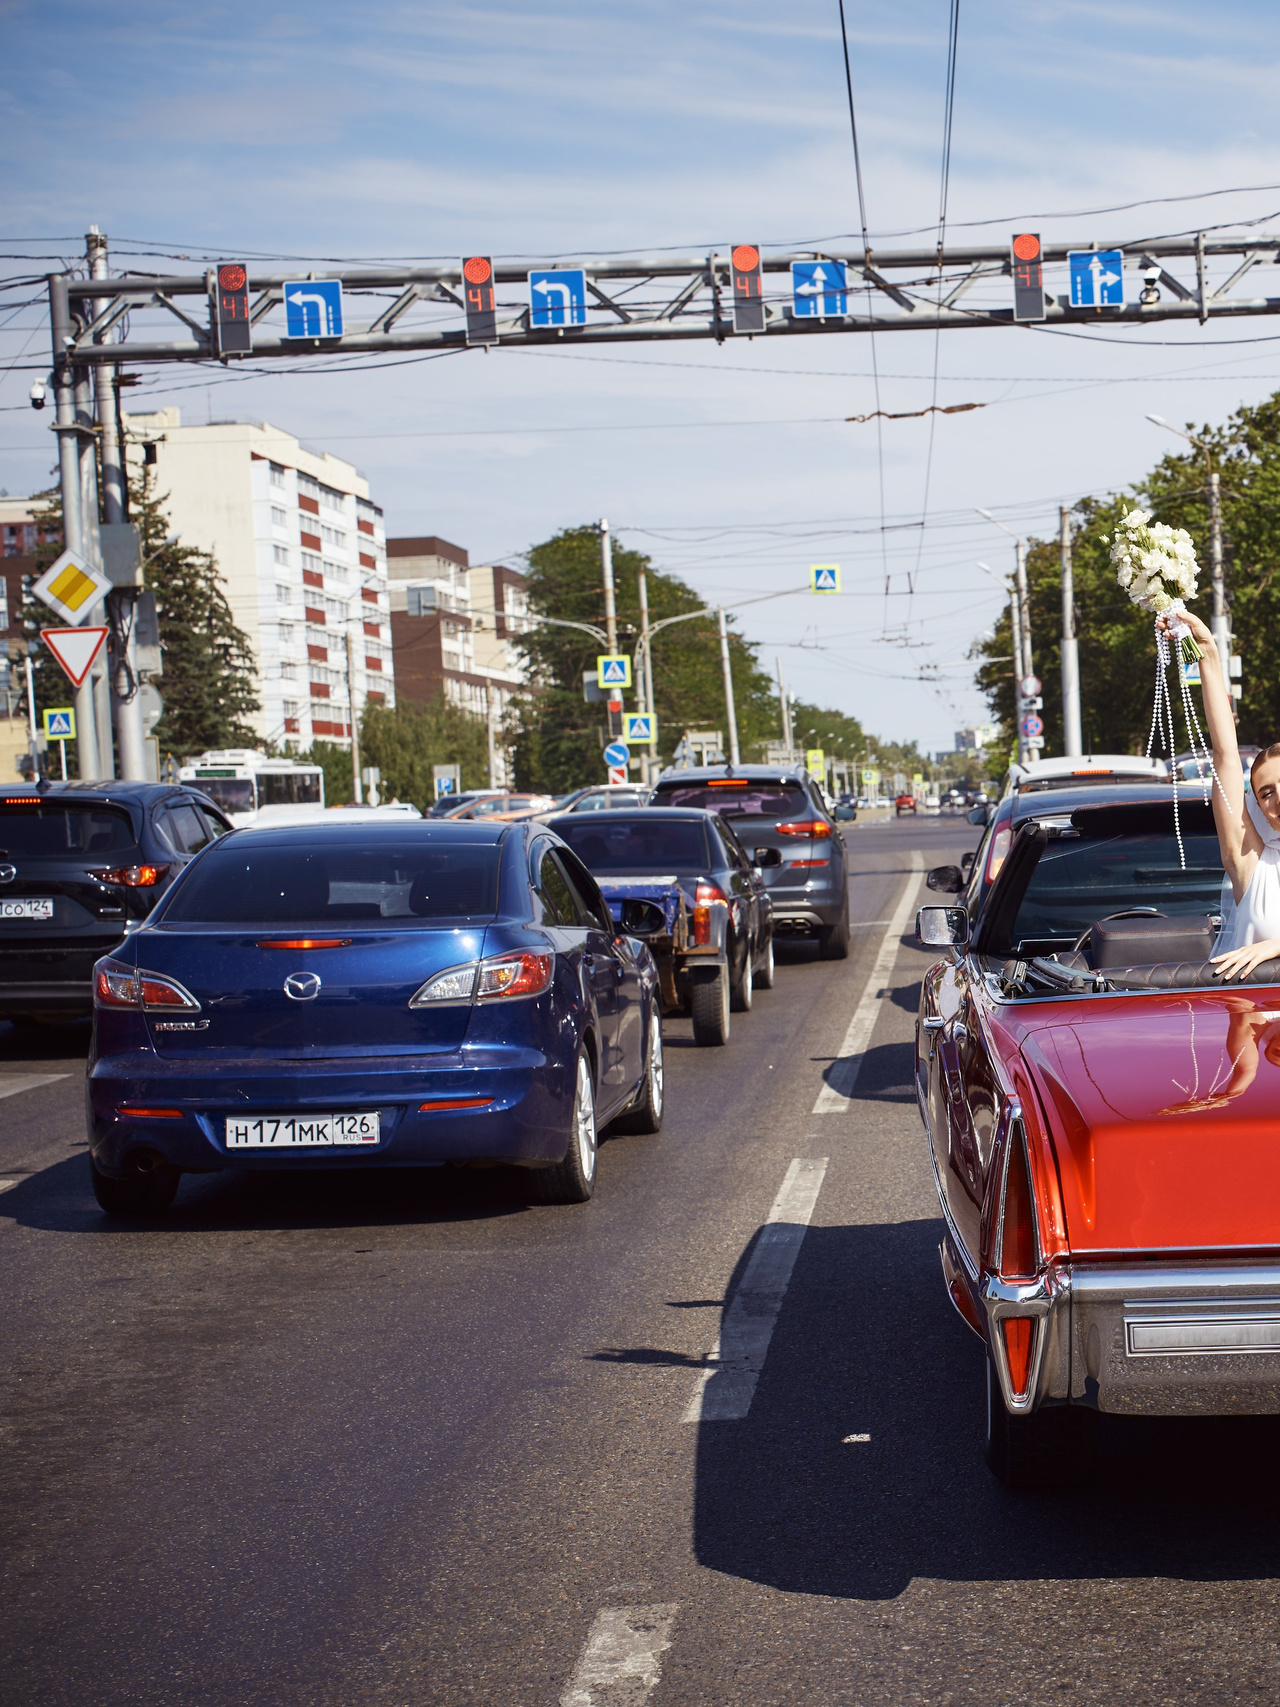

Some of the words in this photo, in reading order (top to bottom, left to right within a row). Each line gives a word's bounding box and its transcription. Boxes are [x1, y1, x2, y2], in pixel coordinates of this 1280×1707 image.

[736, 275, 762, 298] 41
[1018, 264, 1042, 288] 41
[223, 295, 248, 319] 41
[468, 287, 495, 311] 41
[441, 776, 451, 790] P
[26, 900, 48, 911] 124
[235, 1119, 329, 1144] Н171МК
[335, 1115, 370, 1135] 126
[343, 1134, 361, 1142] RUS
